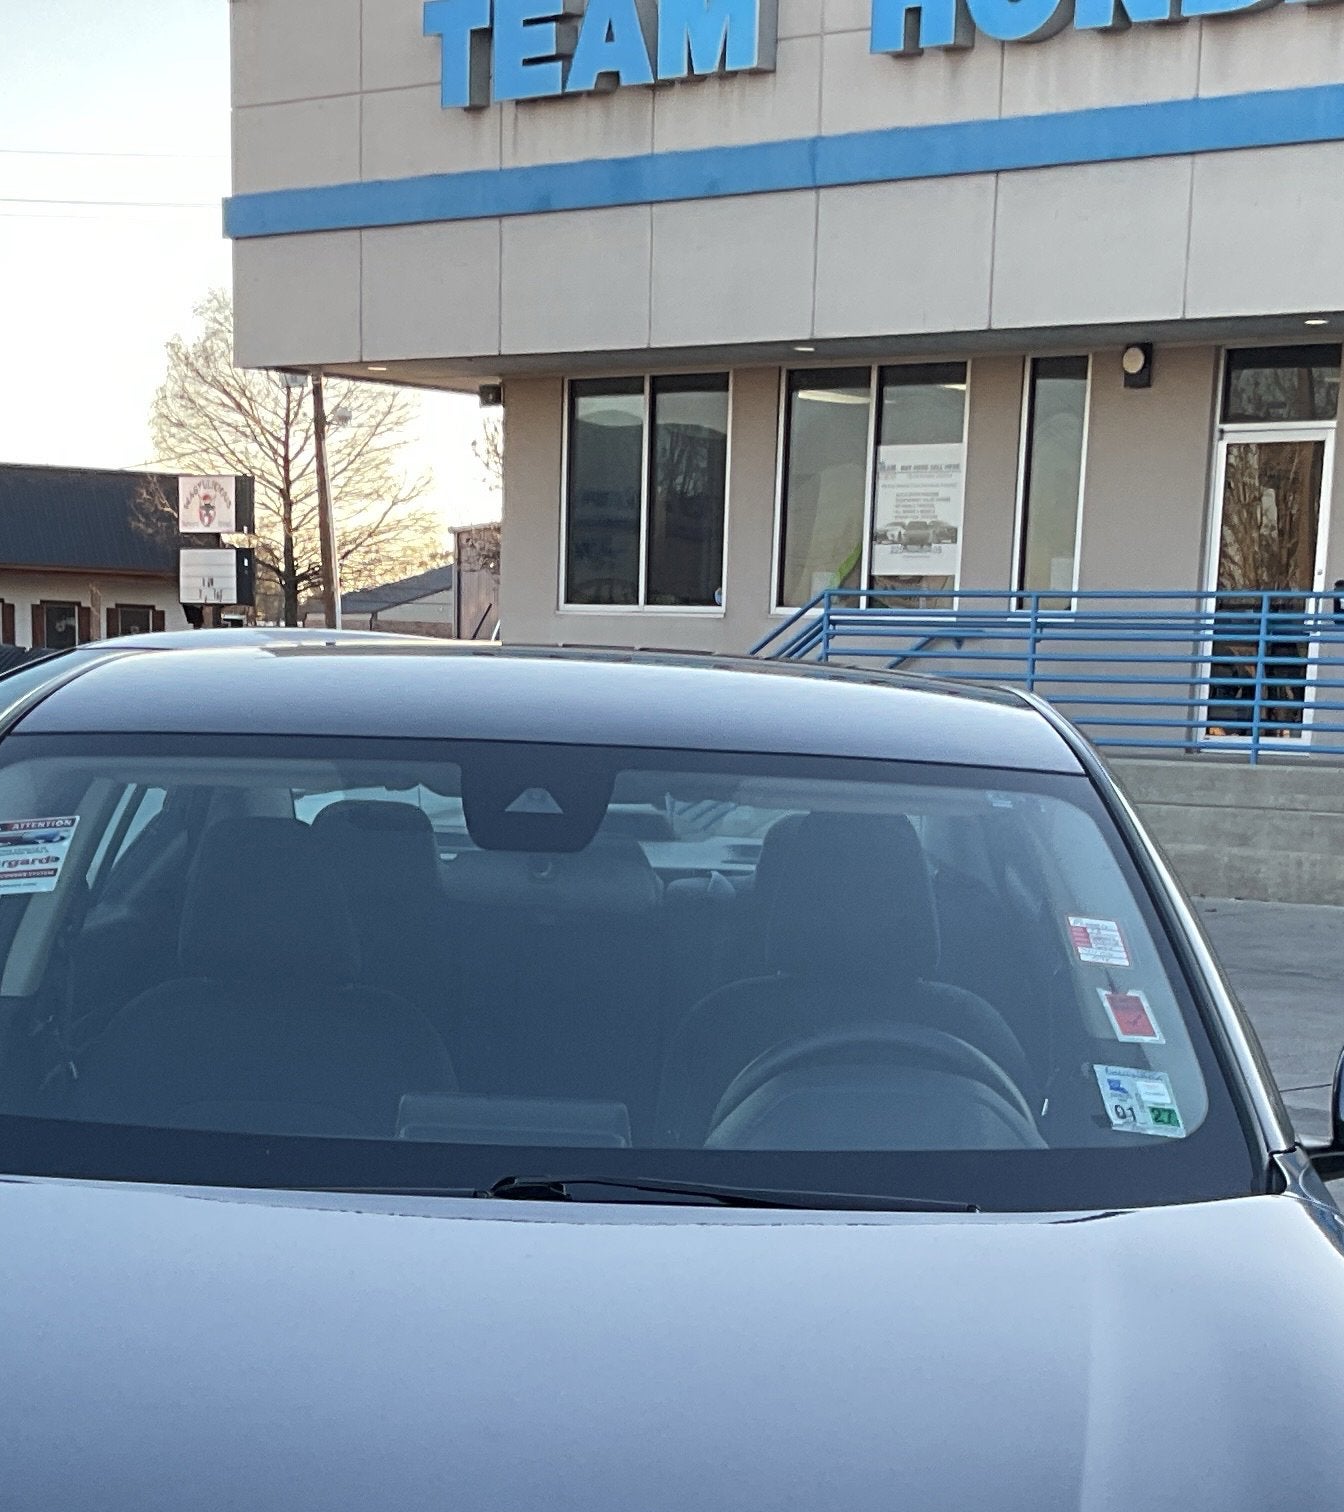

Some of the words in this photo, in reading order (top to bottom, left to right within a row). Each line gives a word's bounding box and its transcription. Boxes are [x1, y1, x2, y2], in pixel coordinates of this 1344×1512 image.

[423, 0, 759, 108] TEAM
[12, 819, 72, 830] ATTENTION
[1115, 1104, 1136, 1122] 01
[1151, 1107, 1178, 1124] 27
